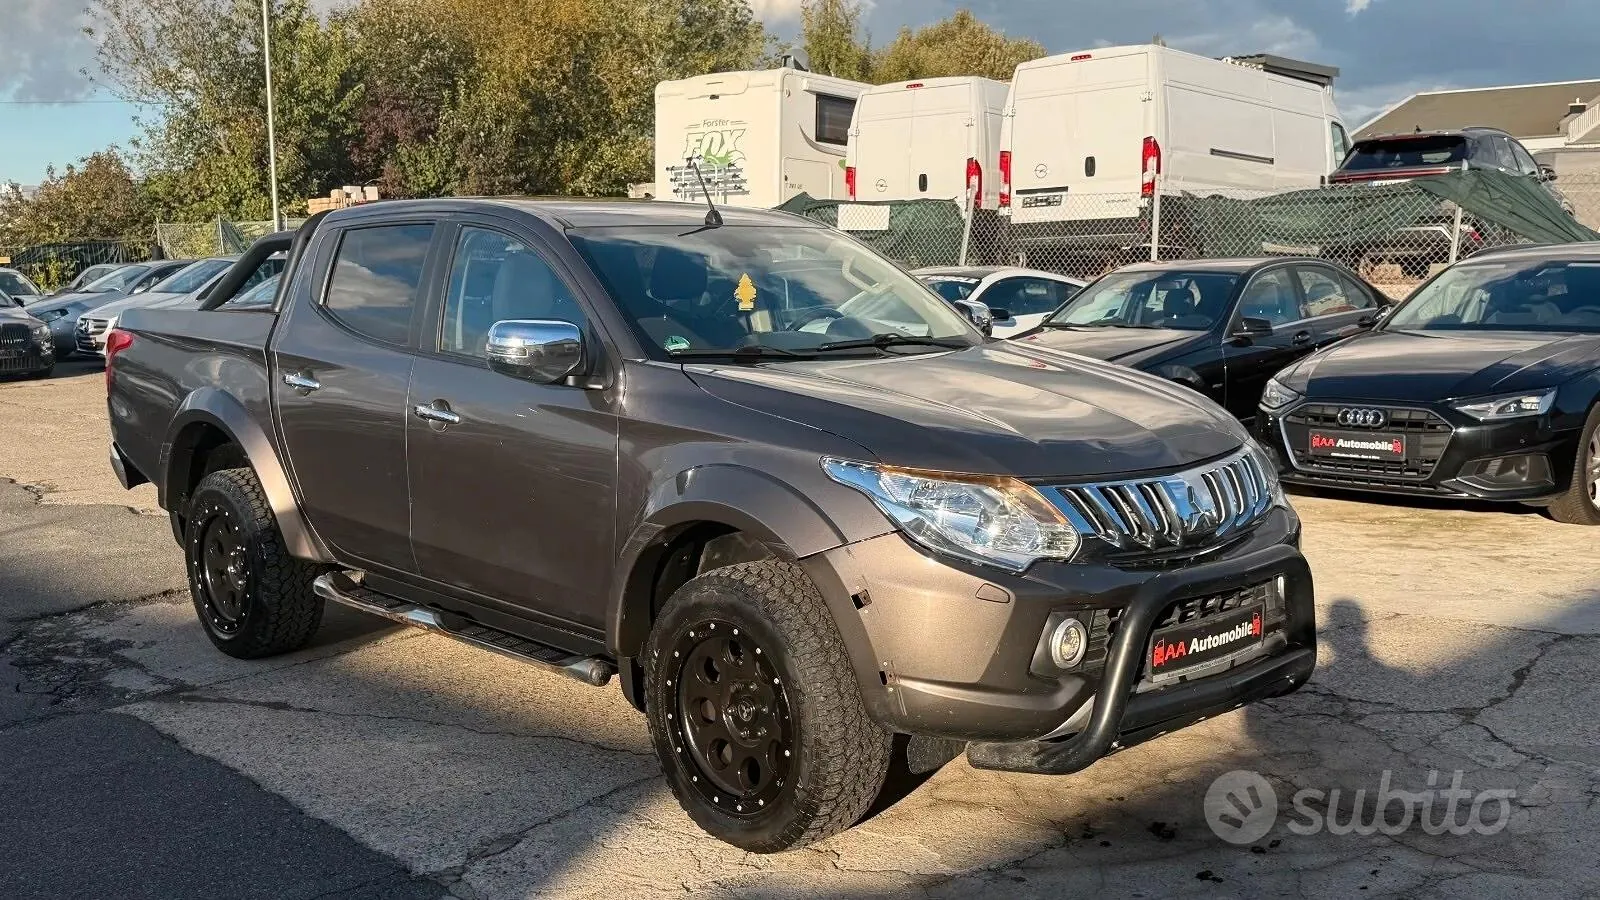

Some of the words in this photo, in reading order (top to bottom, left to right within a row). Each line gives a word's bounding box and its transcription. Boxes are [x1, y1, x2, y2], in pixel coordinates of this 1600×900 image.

[702, 119, 730, 127] Forster
[682, 128, 746, 161] FOX
[1320, 437, 1335, 447] AA
[1336, 438, 1393, 451] Automobile
[1164, 641, 1186, 661] AA
[1188, 621, 1253, 655] Automobile
